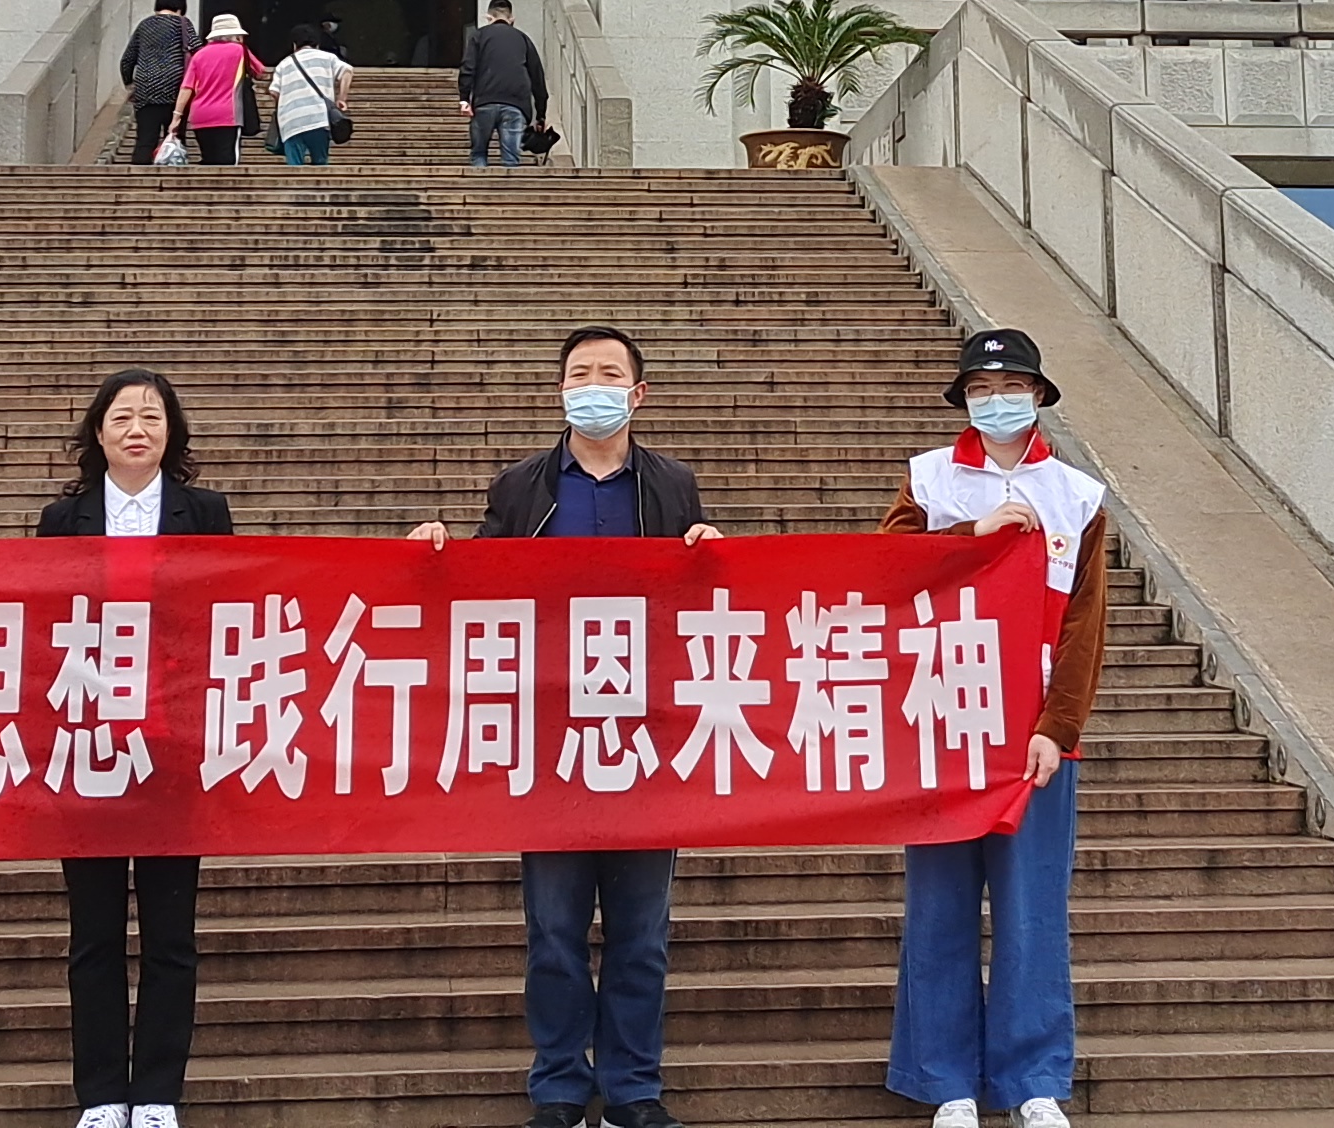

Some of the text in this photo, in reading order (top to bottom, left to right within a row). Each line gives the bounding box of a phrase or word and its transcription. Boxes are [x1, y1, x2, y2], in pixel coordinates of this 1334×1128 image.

[200, 586, 1006, 800] 践行周恩来精神
